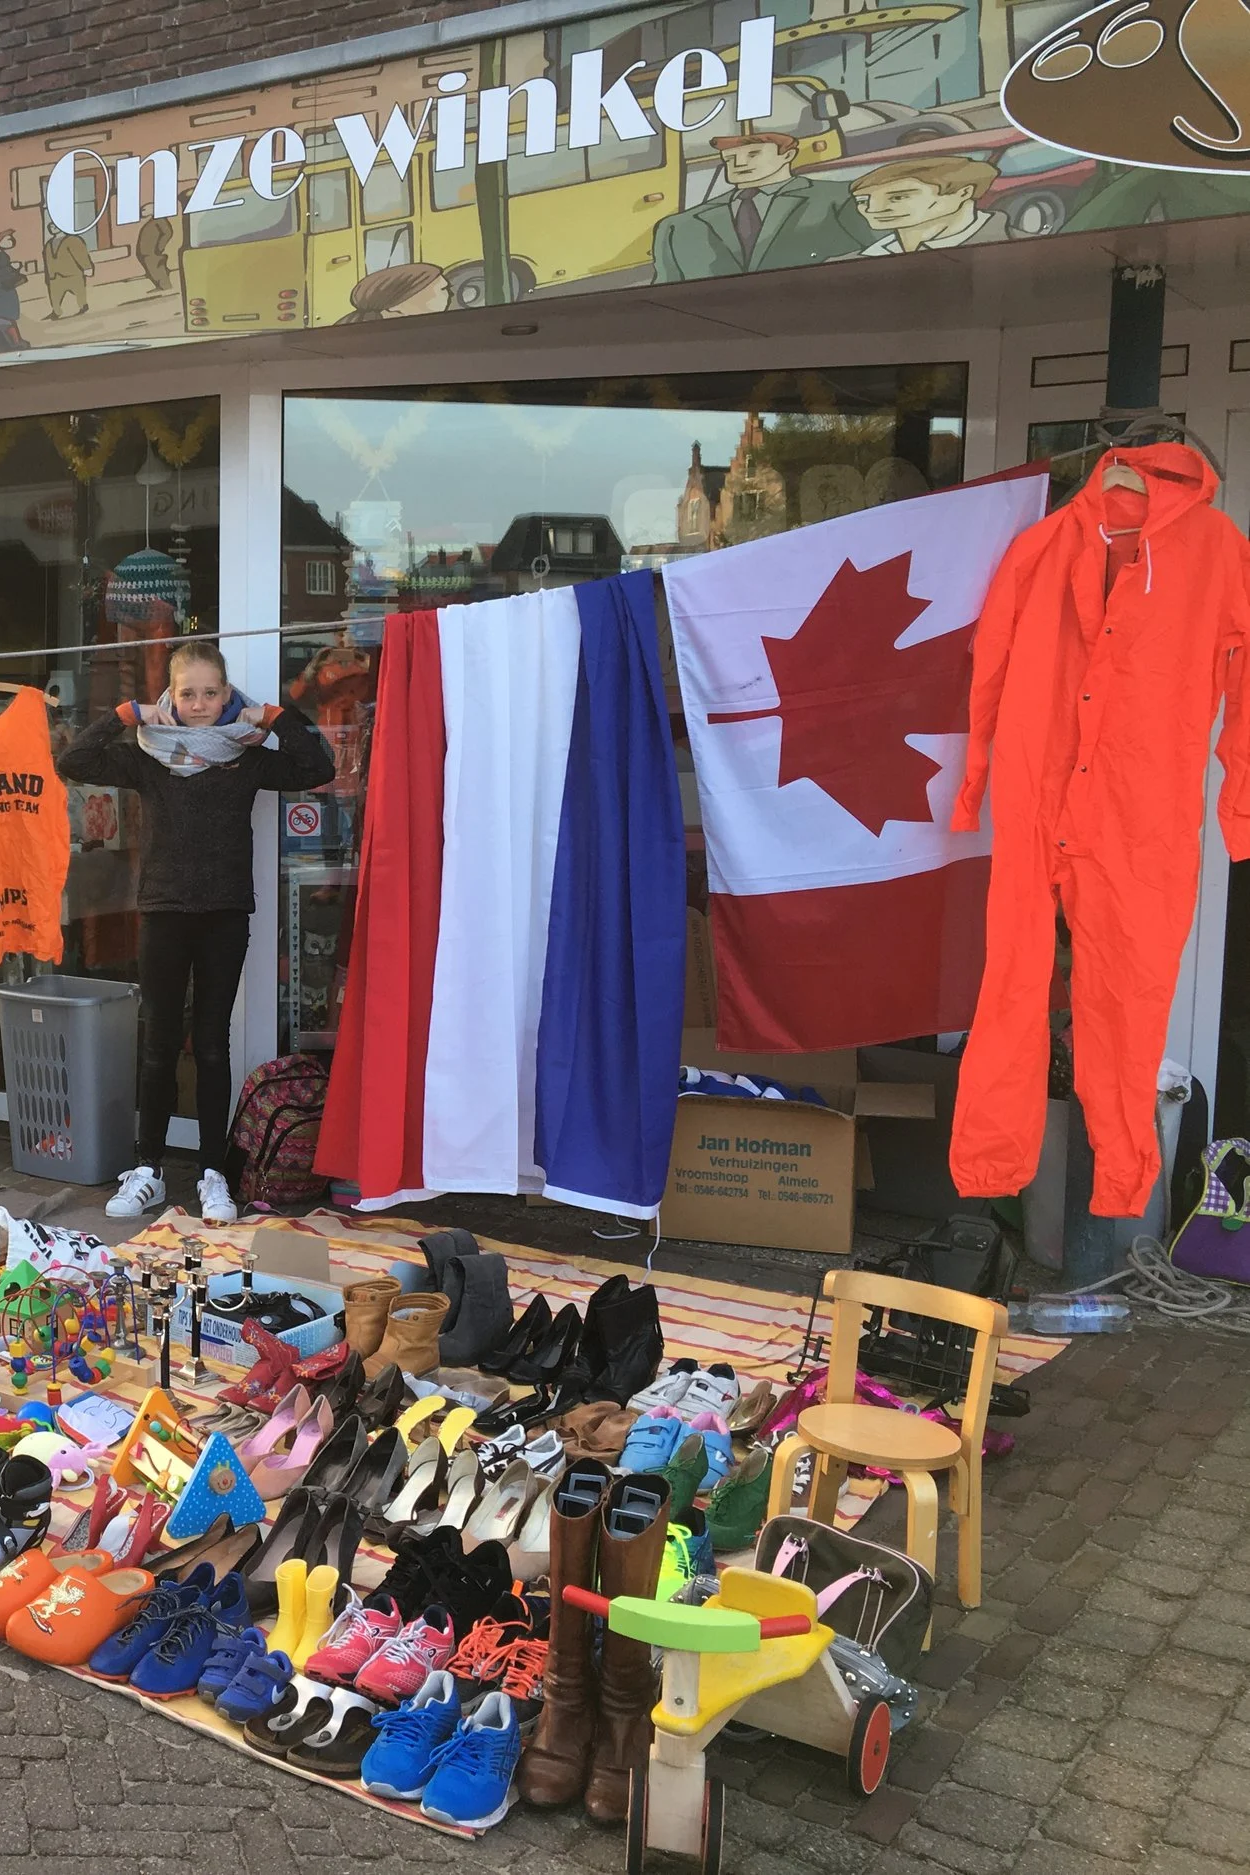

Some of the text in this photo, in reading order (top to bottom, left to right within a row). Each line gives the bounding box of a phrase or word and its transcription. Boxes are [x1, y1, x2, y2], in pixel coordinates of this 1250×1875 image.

[46, 15, 776, 236] Onze winkel
[14, 799, 40, 815] TEAM
[697, 1135, 812, 1157] Jan Hofman
[709, 1156, 799, 1173] Verhuizingen
[675, 1168, 819, 1188] Vroomshoop Almelo
